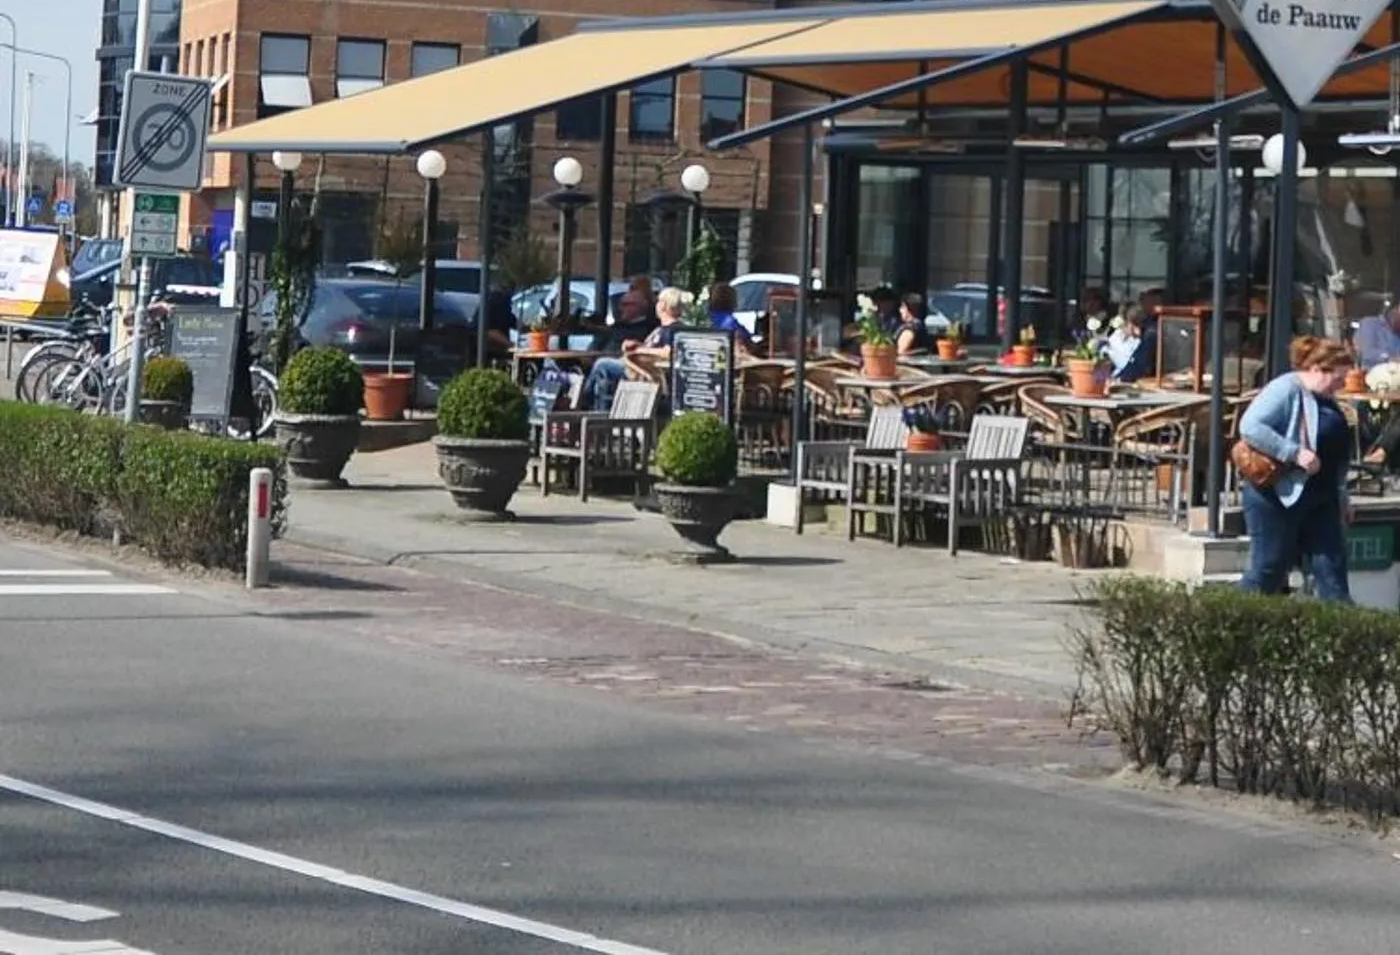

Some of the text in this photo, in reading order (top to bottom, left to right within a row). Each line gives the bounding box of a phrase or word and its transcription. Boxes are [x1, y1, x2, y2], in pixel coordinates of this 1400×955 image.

[1256, 2, 1363, 30] de Paauw
[152, 82, 187, 96] ZONE
[147, 122, 186, 151] 0
